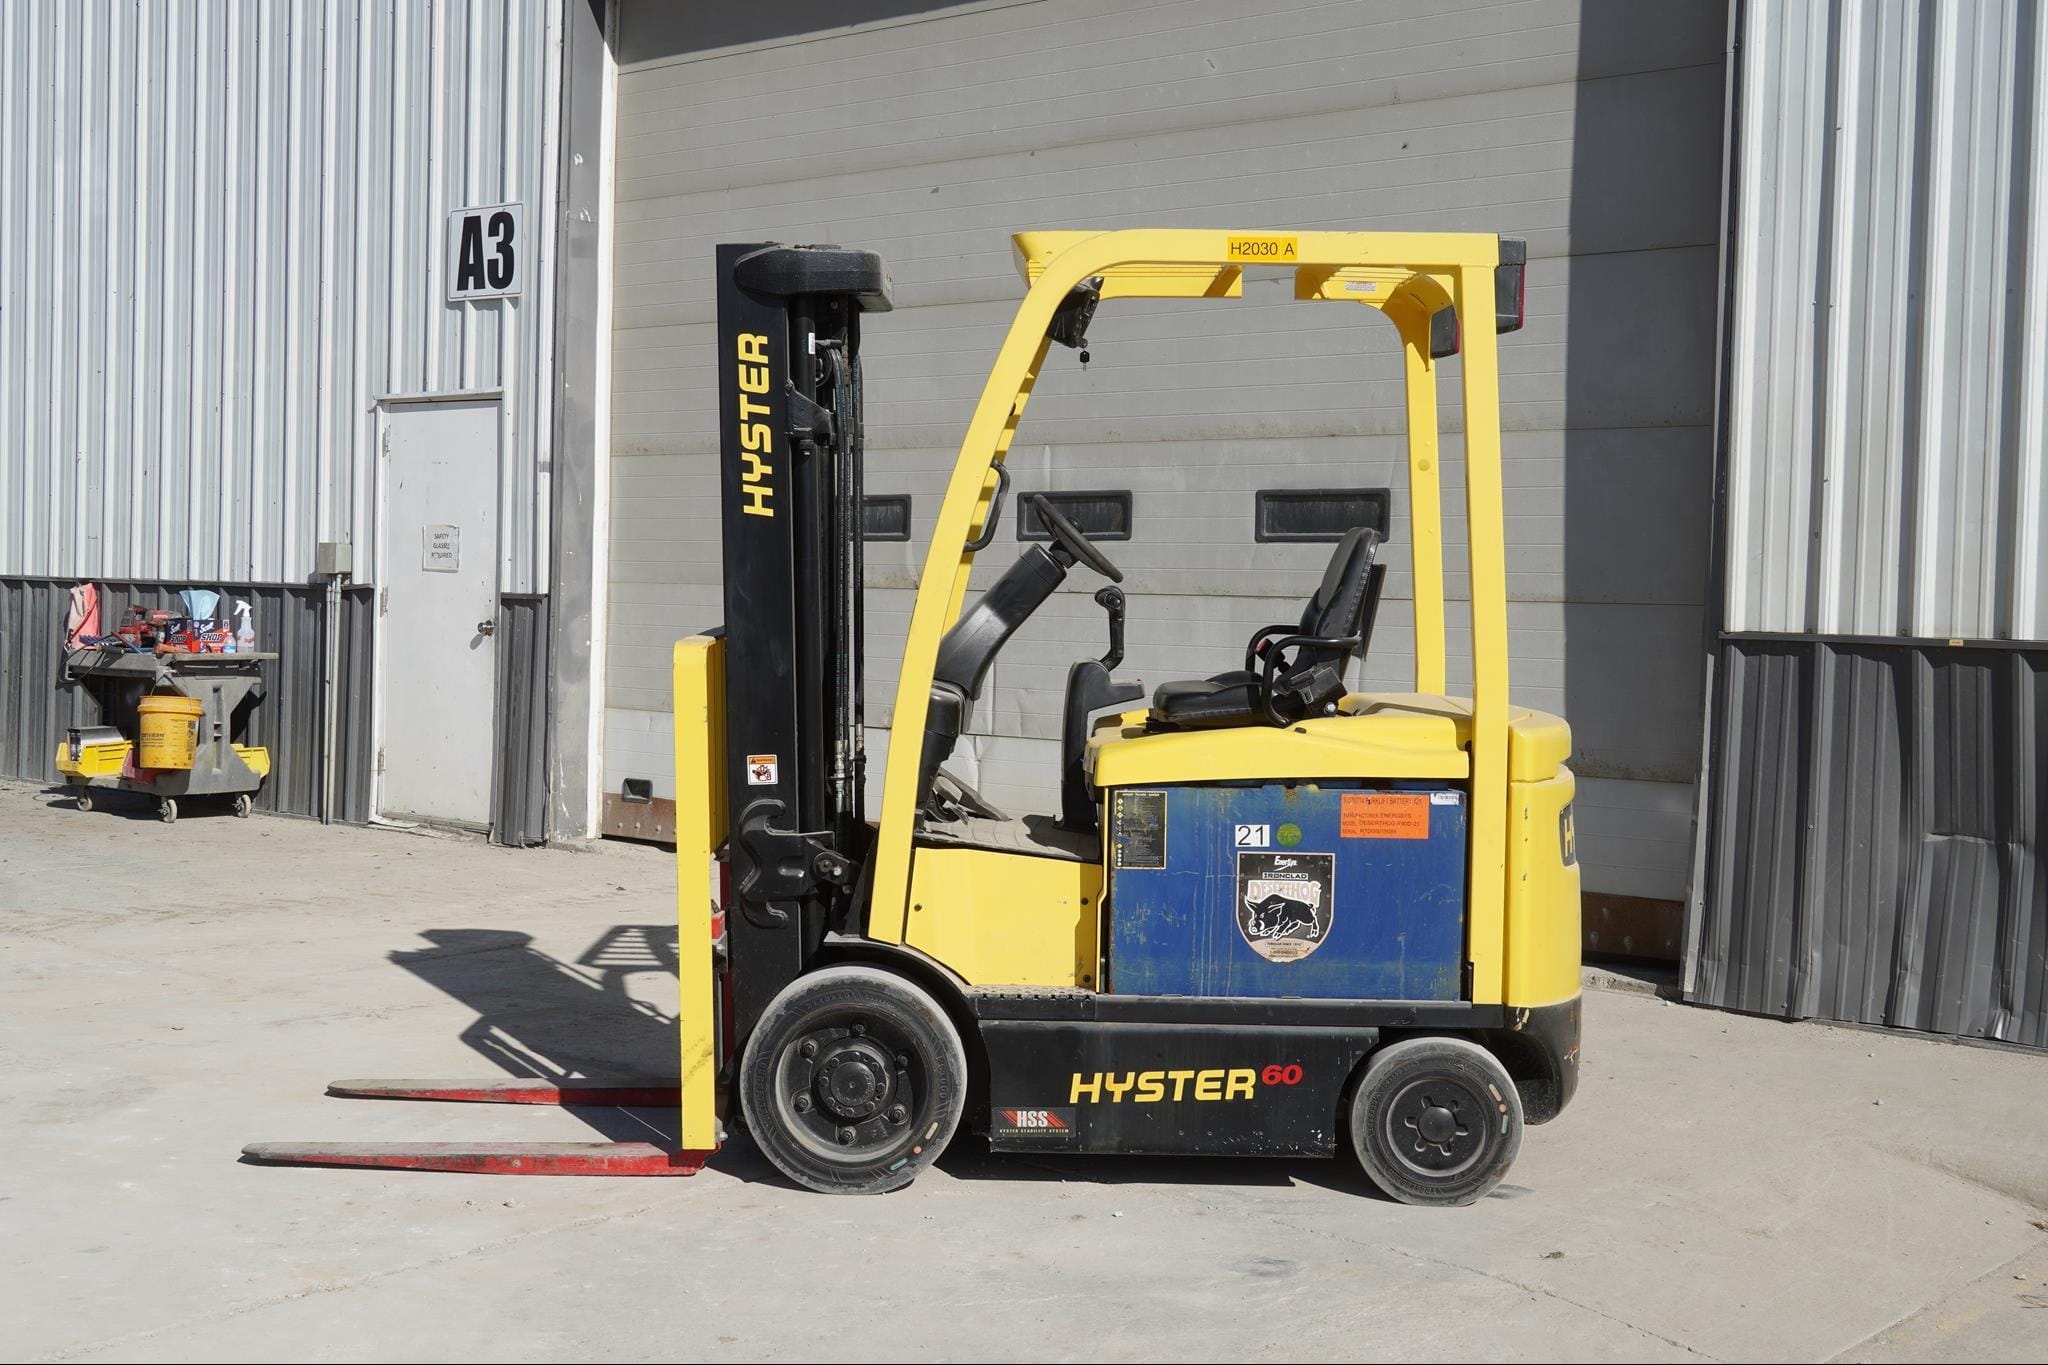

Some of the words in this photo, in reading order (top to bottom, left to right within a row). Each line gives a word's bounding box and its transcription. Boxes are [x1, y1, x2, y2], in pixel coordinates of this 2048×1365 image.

[456, 211, 515, 291] A3
[1230, 242, 1278, 256] H2030
[1283, 243, 1295, 256] A
[737, 333, 774, 517] HYSTER
[201, 633, 223, 641] SHOP
[1237, 825, 1264, 846] 21
[1069, 1068, 1256, 1104] HYSTER
[1261, 1065, 1303, 1085] 60
[1016, 1110, 1048, 1127] HSS
